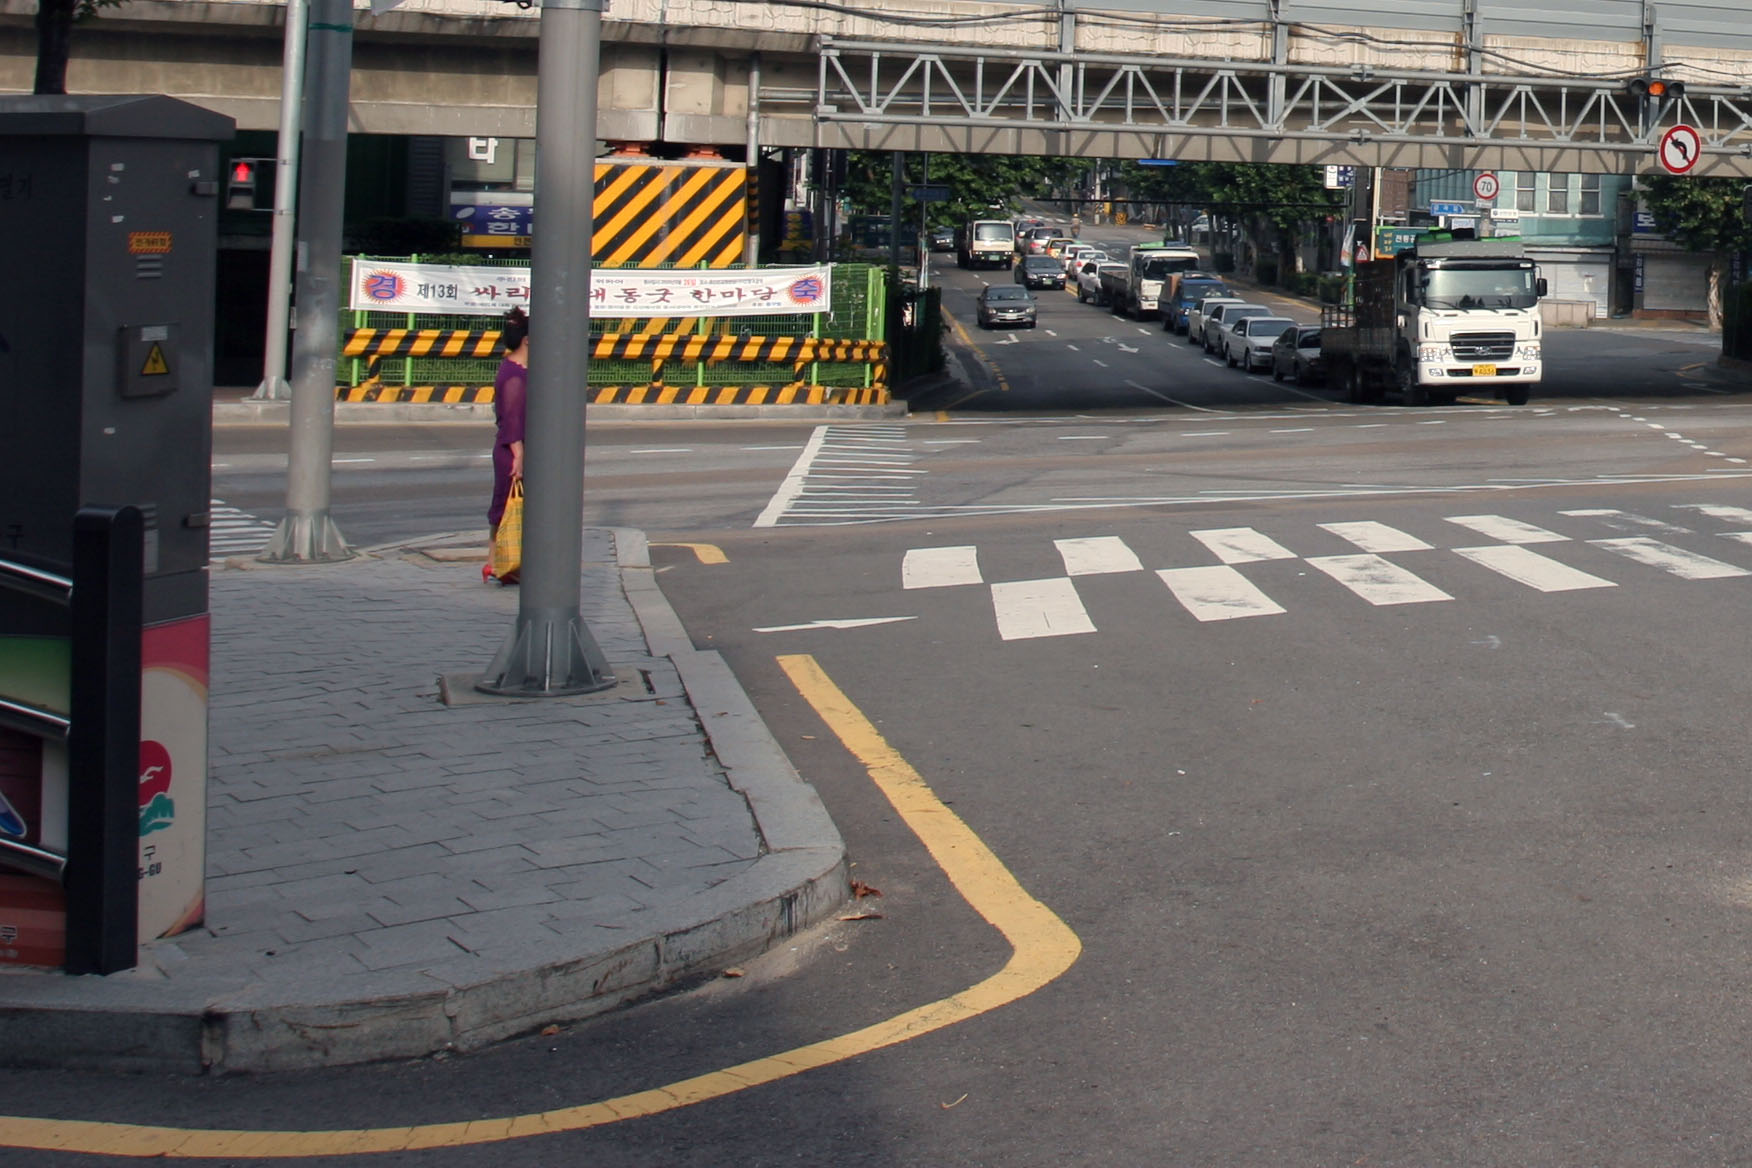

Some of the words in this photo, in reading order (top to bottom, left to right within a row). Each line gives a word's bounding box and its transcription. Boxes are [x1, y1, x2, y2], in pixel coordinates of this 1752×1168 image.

[1480, 181, 1492, 193] 70
[370, 275, 397, 300] 경
[417, 283, 458, 300] 제13회
[690, 286, 778, 303] 한마당
[794, 279, 818, 301] 축
